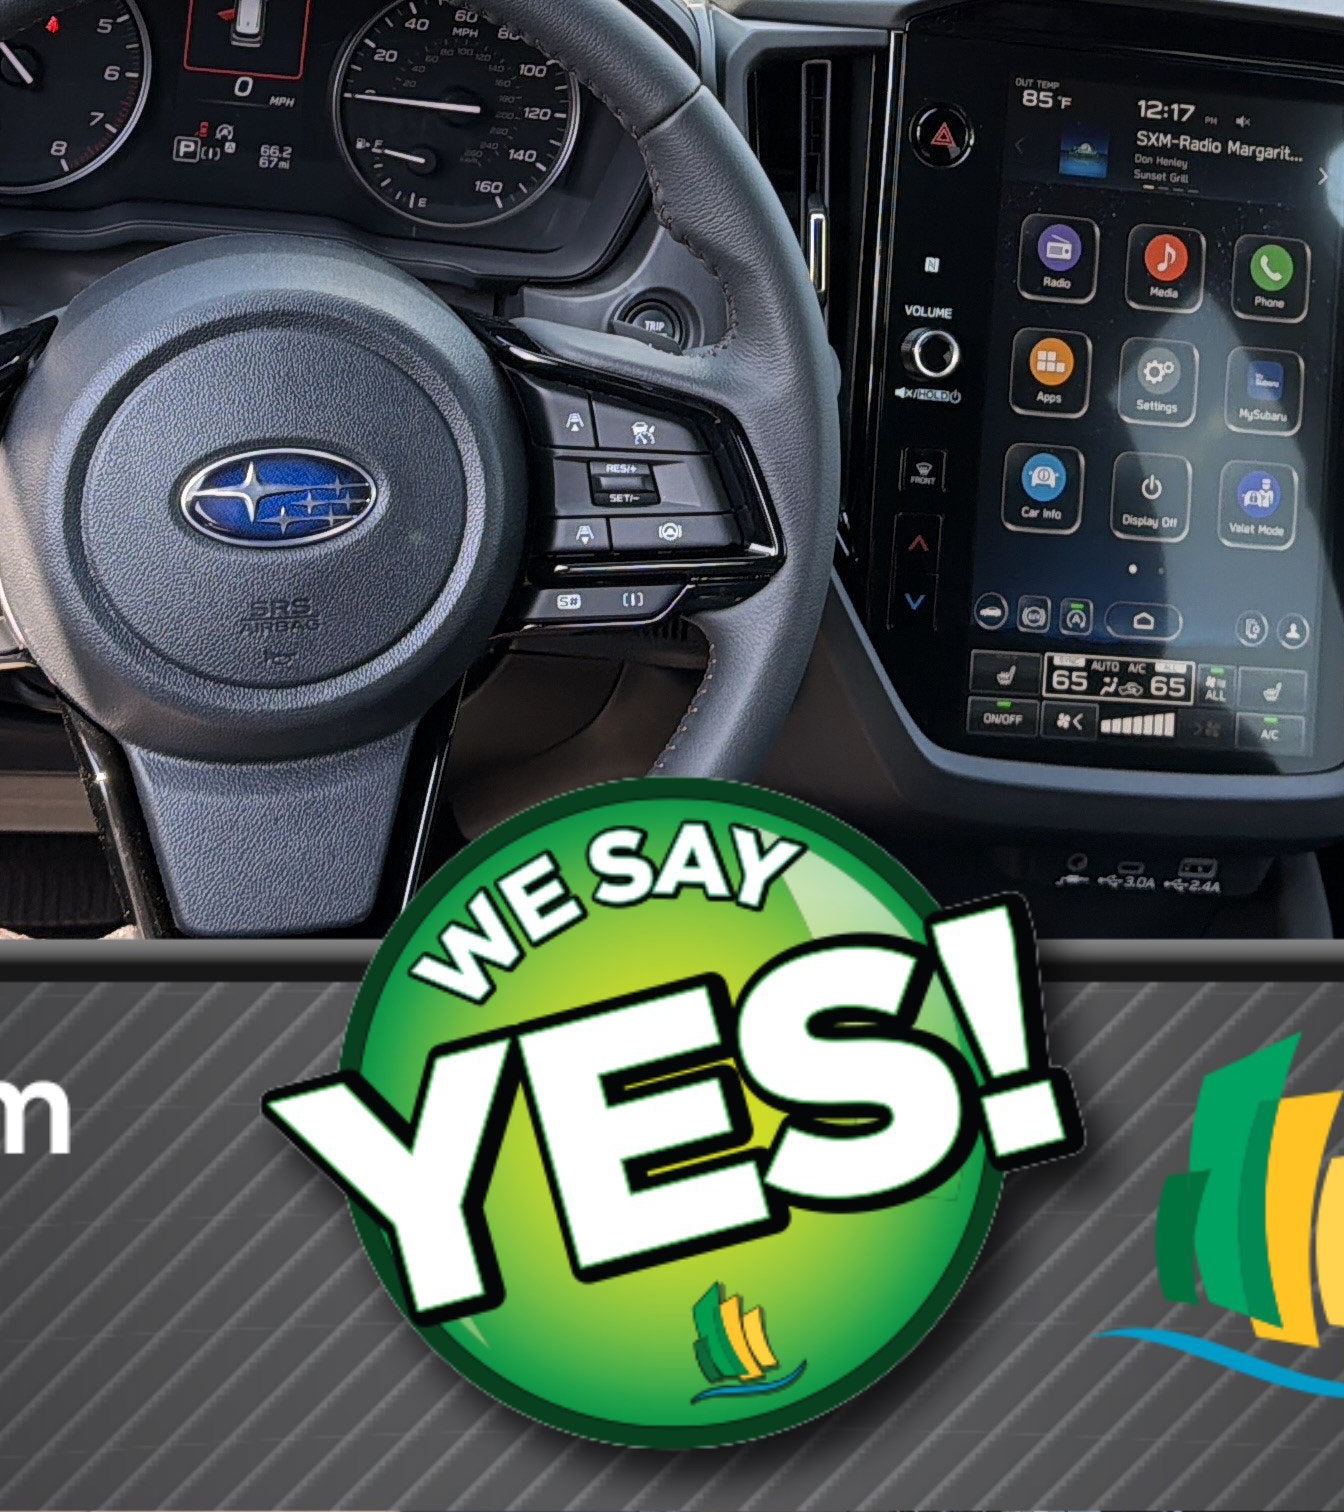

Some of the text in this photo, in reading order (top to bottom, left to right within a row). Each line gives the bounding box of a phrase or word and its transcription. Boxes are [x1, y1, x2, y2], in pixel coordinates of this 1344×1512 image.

[455, 10, 478, 23] 60
[96, 18, 114, 34] 5
[405, 18, 430, 31] 40
[452, 27, 478, 38] MPH
[374, 49, 398, 62] 20
[103, 65, 121, 81] 6
[519, 64, 547, 78] 100
[234, 76, 254, 97] 0
[1015, 77, 1060, 89] OUT TEMP
[269, 95, 296, 108] MPH
[1022, 89, 1053, 108] 85
[524, 107, 551, 120] 120
[1137, 99, 1196, 122] 12:17
[89, 111, 105, 127] 7
[50, 140, 68, 156] 8
[1136, 130, 1222, 155] SXM-Radio
[260, 144, 293, 158] 66.2
[508, 148, 537, 162] 140
[1134, 153, 1188, 170] Don Henley
[1134, 168, 1189, 184] Sunset Grill
[475, 181, 503, 194] 160
[418, 197, 427, 208] E
[1043, 276, 1071, 289] Radio
[1150, 287, 1178, 299] Media
[1254, 296, 1285, 308] Phone
[905, 304, 953, 319] VOLUME
[1036, 391, 1062, 404] Apps
[1136, 399, 1178, 413] Settings
[1239, 408, 1288, 423] MySubaru
[910, 476, 936, 486] FRONT
[1021, 506, 1062, 520] Car Info
[1122, 514, 1177, 529] Display Off
[1229, 522, 1285, 536] Valet Mode
[249, 598, 312, 618] SRS
[1091, 660, 1146, 674] AUTO A/C
[1052, 670, 1088, 691] 65
[1151, 676, 1186, 697] 65
[1205, 690, 1227, 702] ALL
[983, 712, 1023, 726] ON/OFF
[1260, 729, 1279, 741] A/C
[1123, 876, 1156, 888] 3.0A
[1188, 880, 1222, 894] 2.4A
